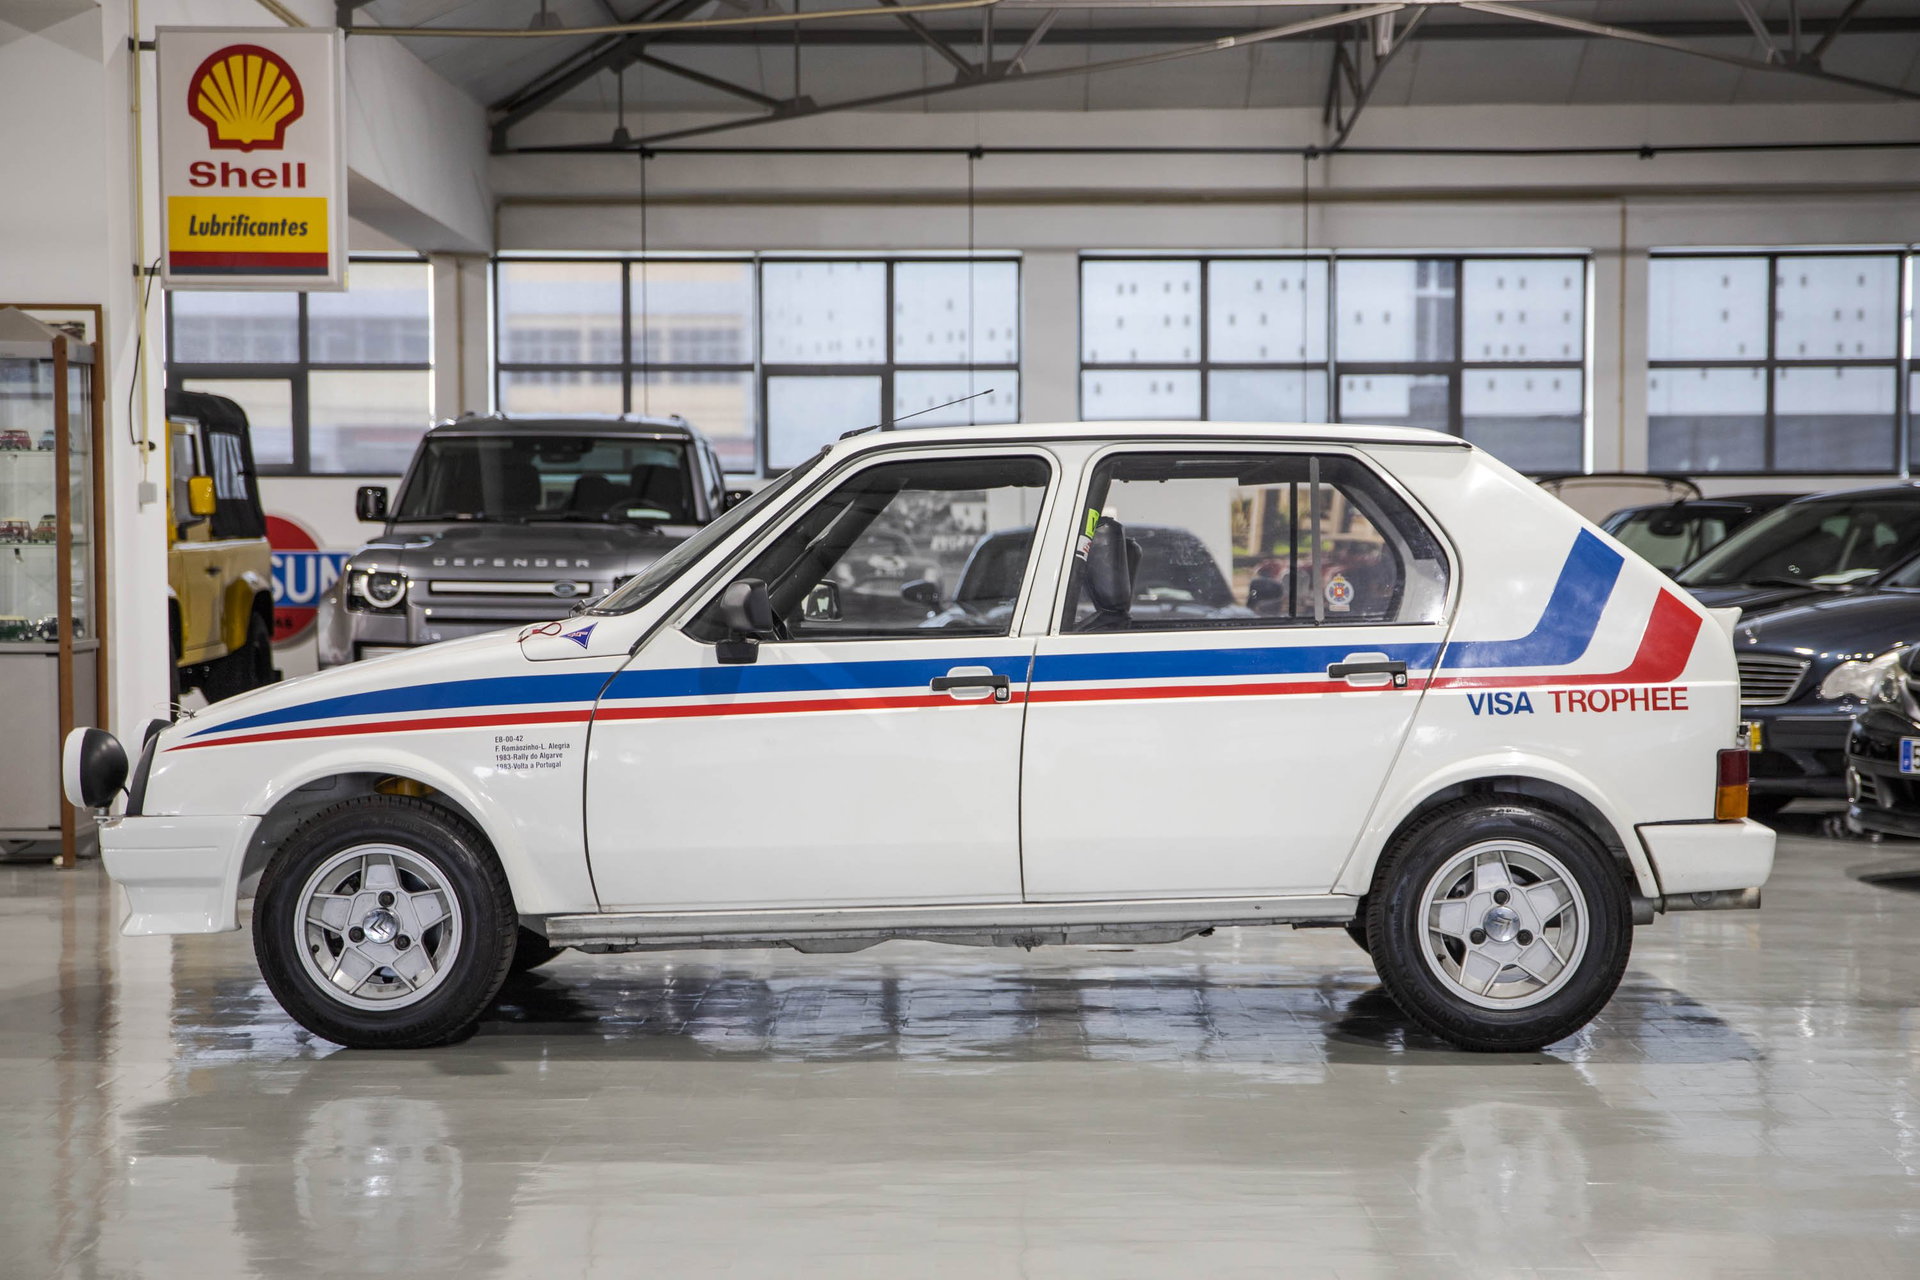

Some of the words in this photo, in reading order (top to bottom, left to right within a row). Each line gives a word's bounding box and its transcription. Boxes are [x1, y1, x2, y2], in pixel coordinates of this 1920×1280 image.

[189, 161, 306, 188] Shell
[188, 214, 308, 236] Lubrificantes
[433, 558, 590, 568] DEFENDER
[1466, 691, 1534, 716] VISA
[1548, 686, 1689, 713] TROPHEE
[495, 735, 524, 743] EB-00-42
[548, 743, 570, 751] Alegria
[496, 753, 528, 761] 1983-Rally
[540, 752, 563, 760] Algarve
[536, 761, 562, 769] Portugal
